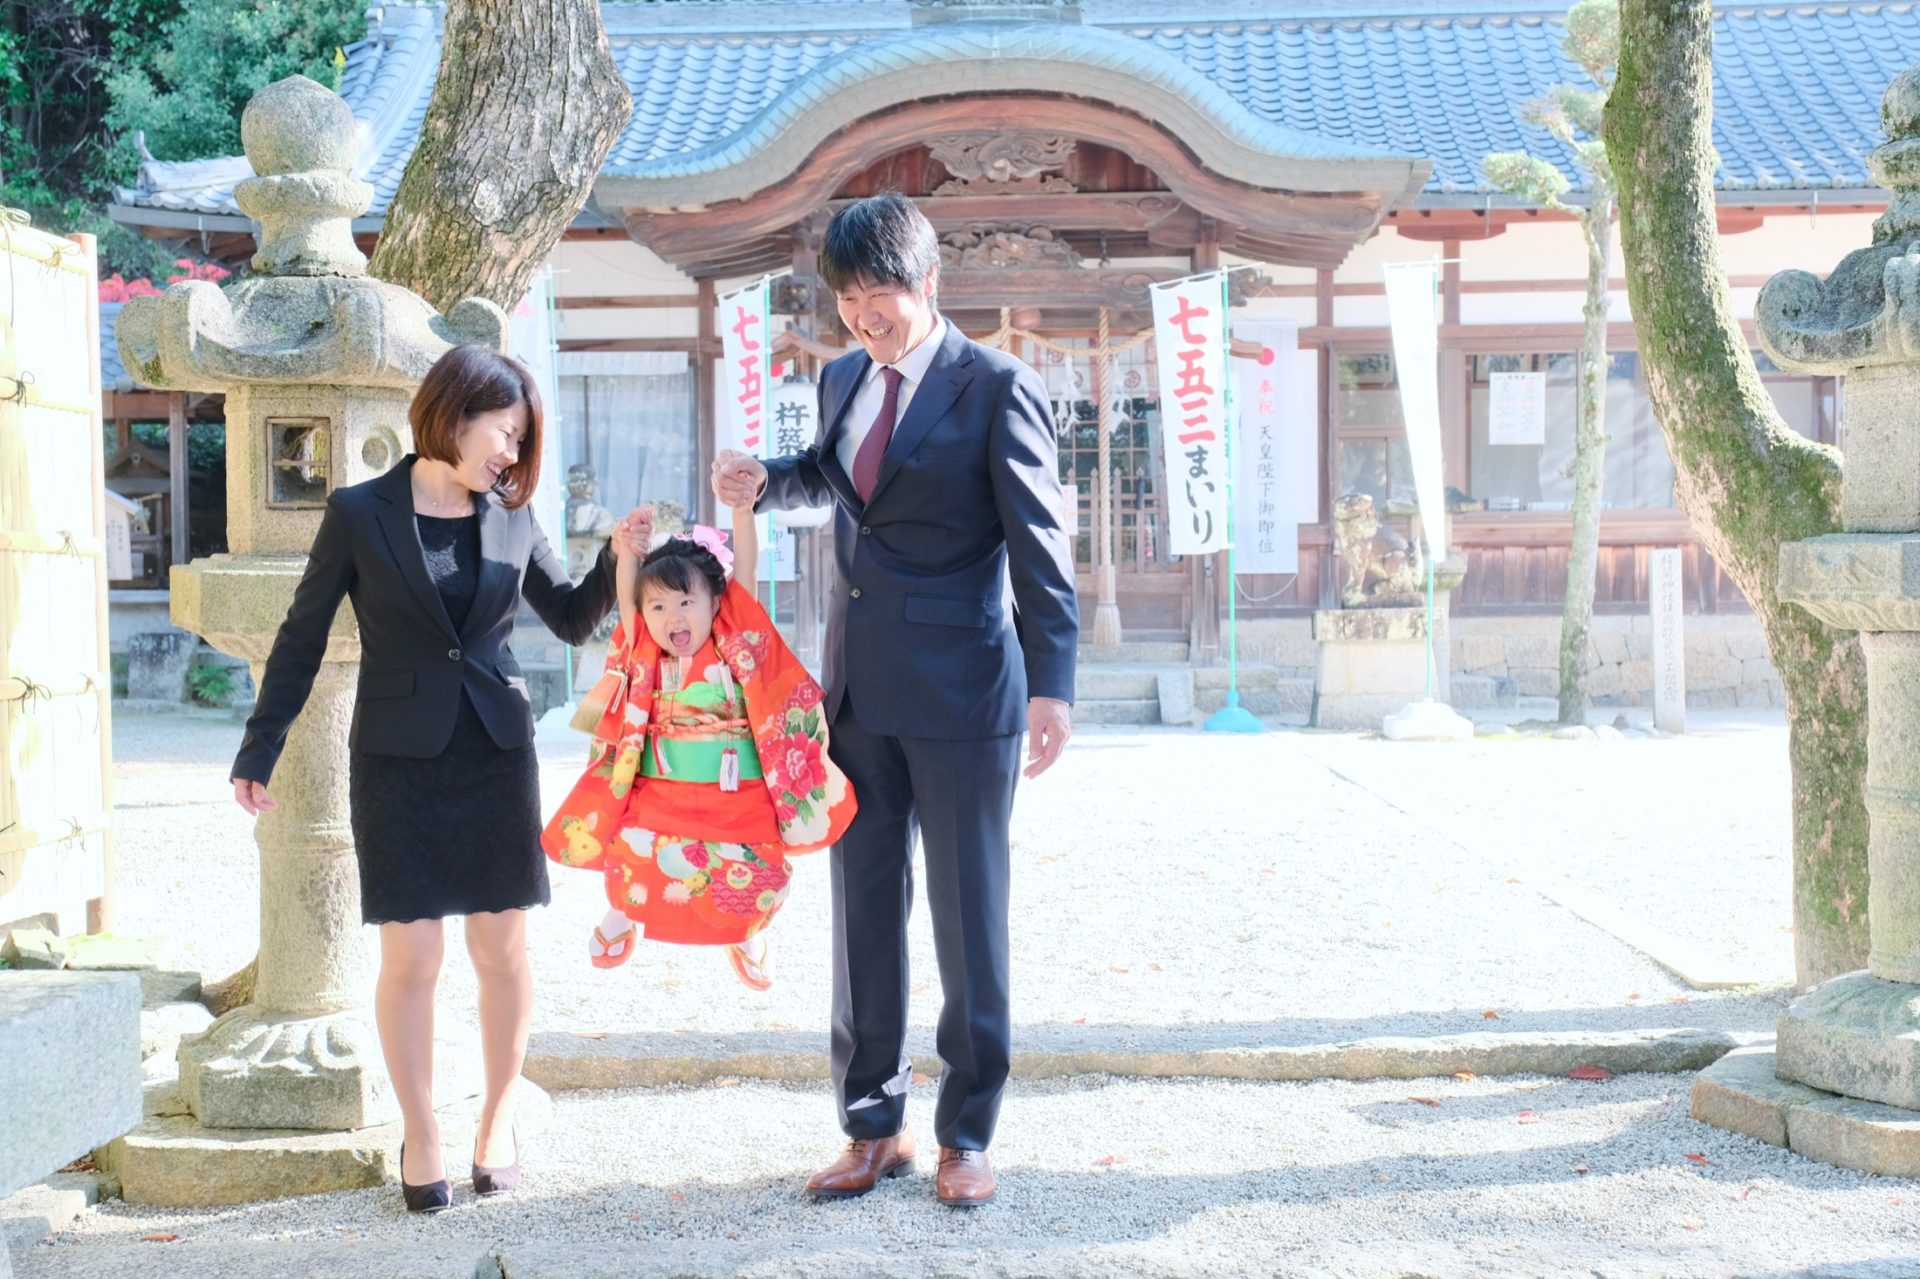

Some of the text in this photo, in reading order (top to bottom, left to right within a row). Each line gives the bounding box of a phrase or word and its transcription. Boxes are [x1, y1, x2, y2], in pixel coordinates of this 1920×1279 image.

[731, 305, 761, 460] 七五三
[775, 401, 810, 456] 杵築
[1168, 296, 1217, 545] 七五三まいり
[1257, 424, 1275, 554] 天皇陛下御即位
